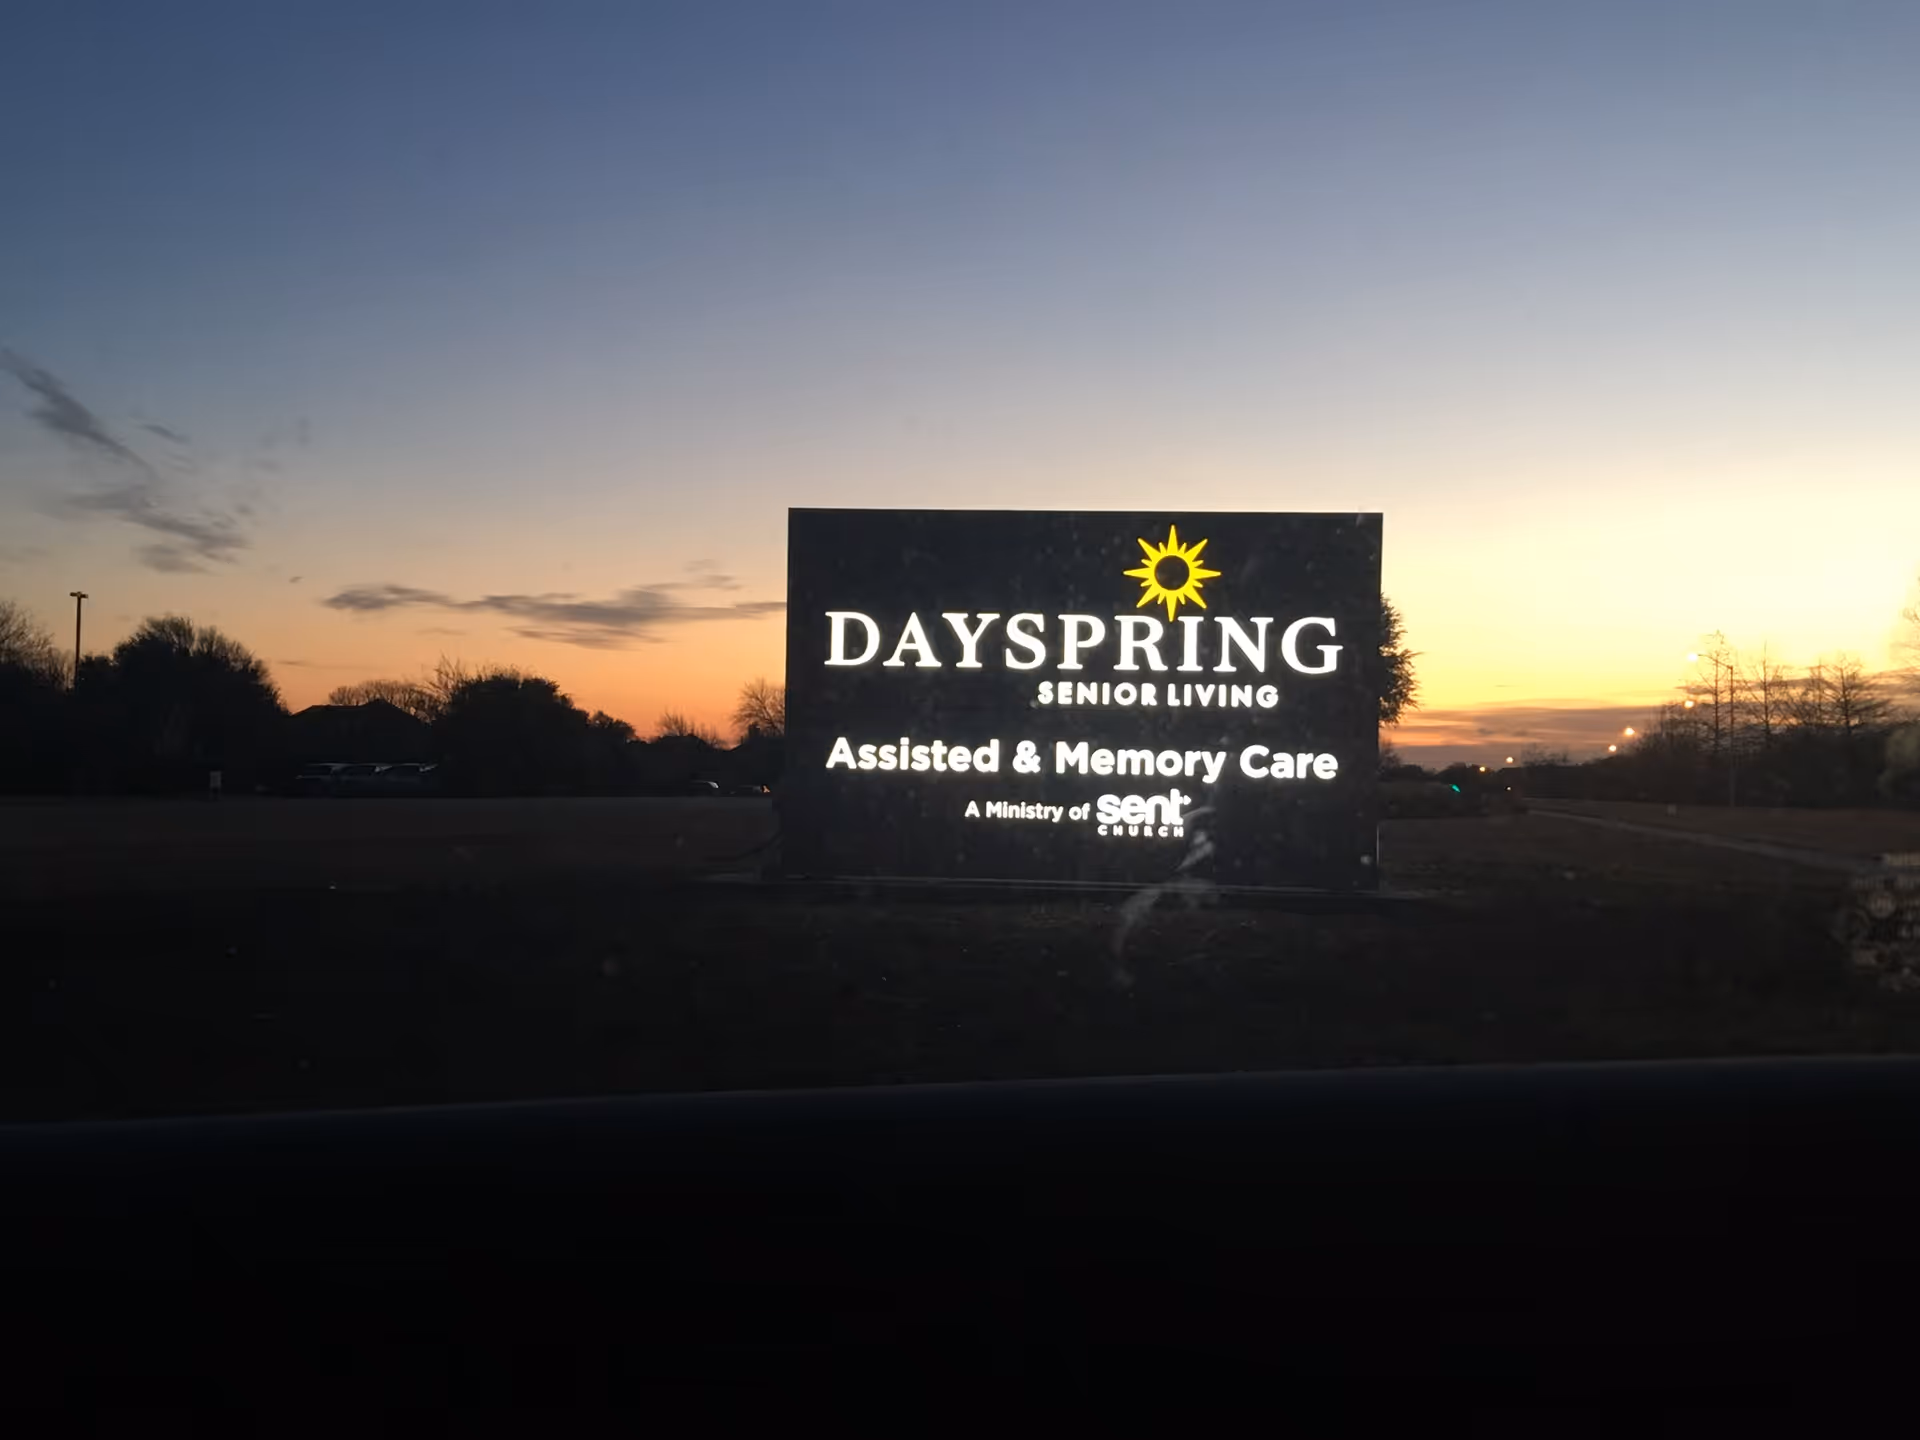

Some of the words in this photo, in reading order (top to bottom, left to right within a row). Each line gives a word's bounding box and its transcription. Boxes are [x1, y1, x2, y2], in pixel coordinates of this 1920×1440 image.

[823, 610, 1344, 675] DAYSPRING
[1036, 680, 1158, 707] SENIOR
[1166, 683, 1280, 709] LIVING
[825, 736, 1000, 774] Assisted
[1012, 739, 1042, 774] &
[1055, 740, 1227, 784] Memory
[1239, 744, 1339, 780] Care
[964, 800, 981, 818] A
[985, 800, 1064, 823] Ministry
[1068, 802, 1091, 821] of
[1095, 788, 1190, 826] sent
[1097, 824, 1185, 838] CHURCH
